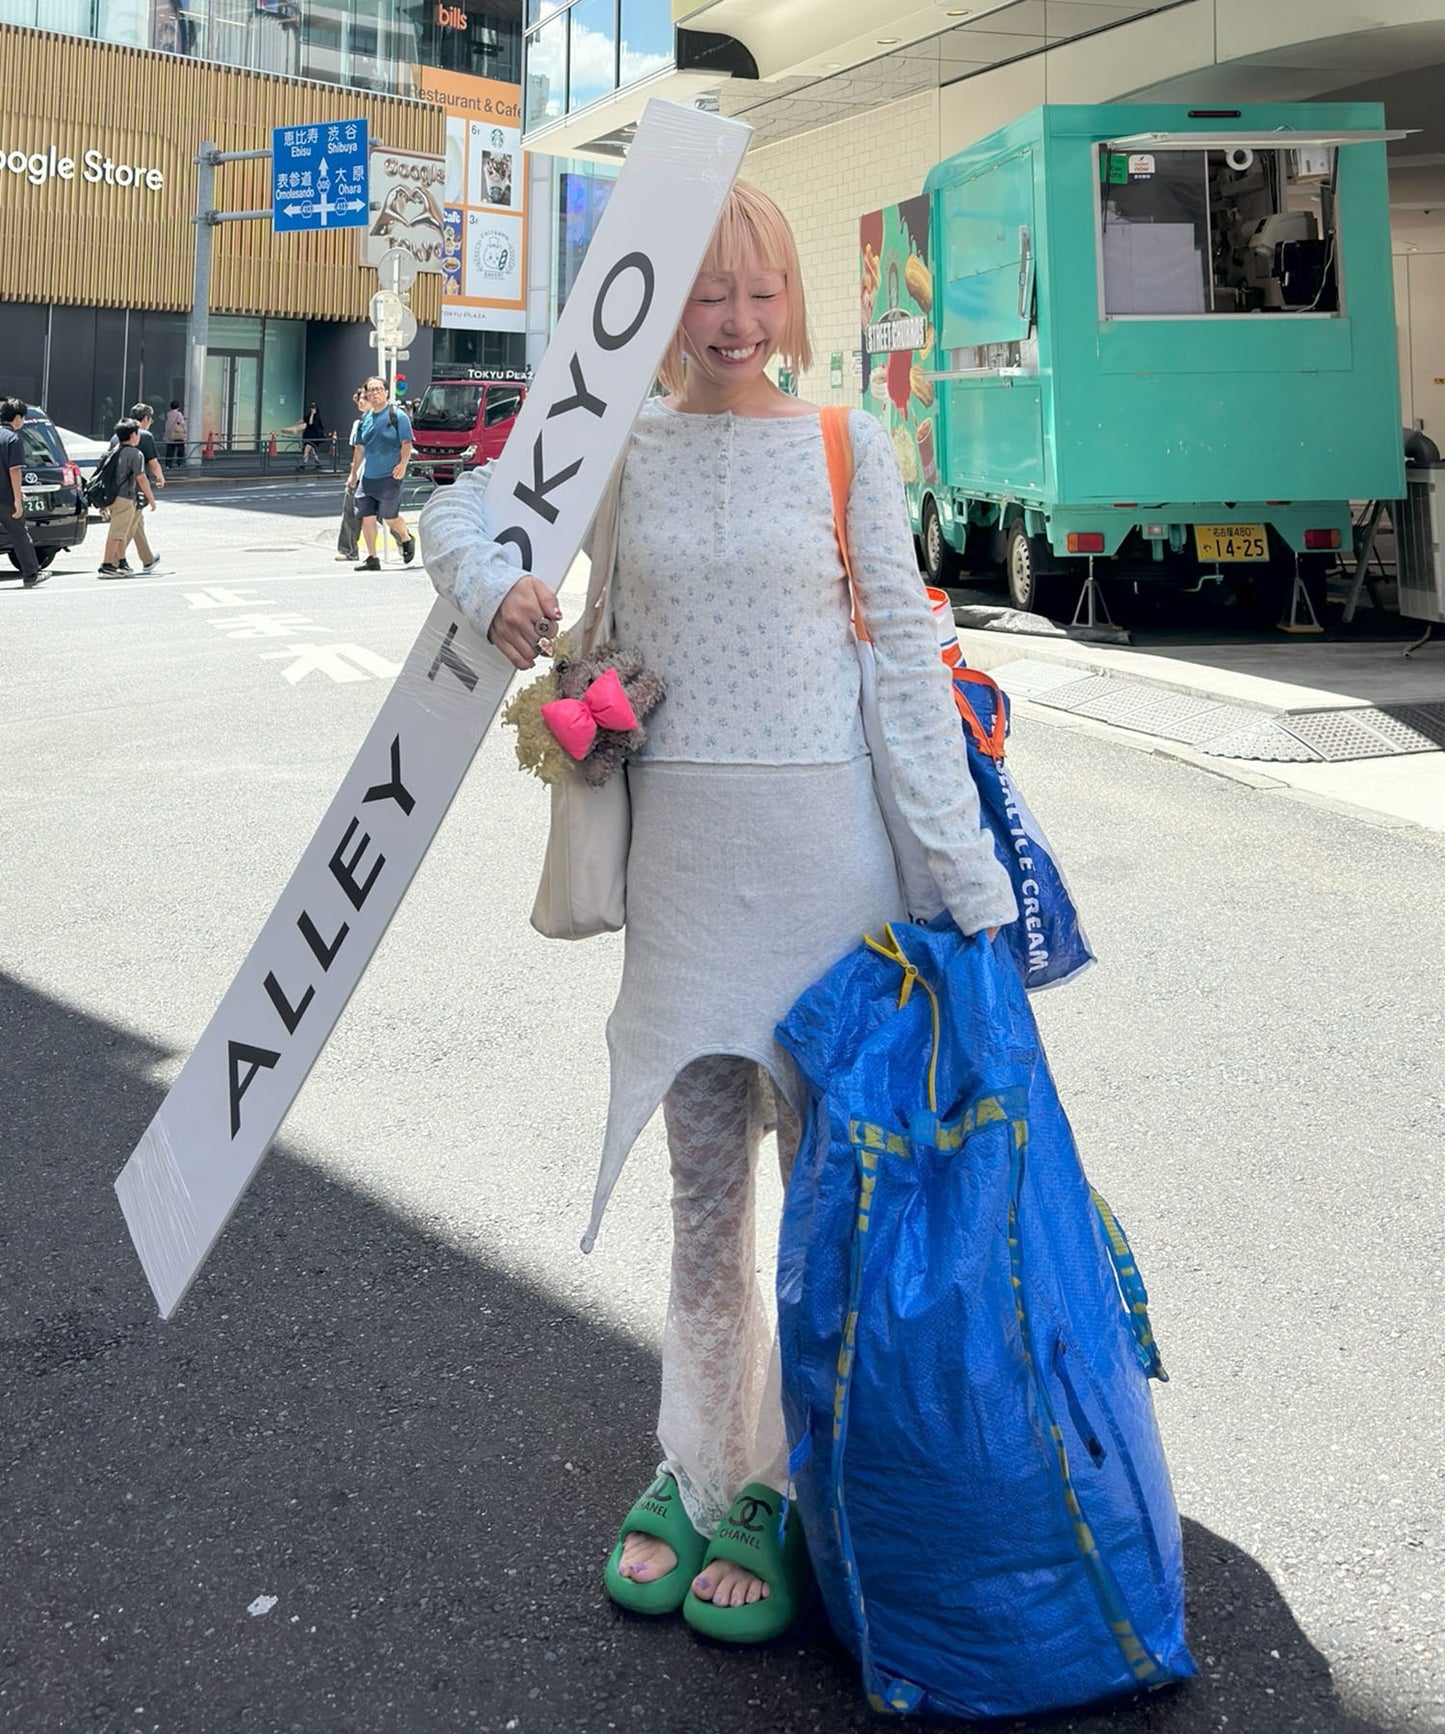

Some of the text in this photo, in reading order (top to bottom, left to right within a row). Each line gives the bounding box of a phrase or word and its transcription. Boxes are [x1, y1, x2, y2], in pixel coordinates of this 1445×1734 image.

[437, 4, 468, 31] bills
[484, 98, 493, 113] &
[284, 127, 318, 146] 恵比寿
[327, 124, 357, 142] 渋谷
[291, 146, 311, 158] Ebisu
[327, 142, 358, 154] Shibuya
[0, 145, 163, 191] ogle Store
[335, 165, 364, 183] 大原
[277, 171, 312, 188] 表参道
[275, 187, 315, 200] Omotesando
[338, 184, 362, 195] Ohara
[468, 369, 535, 380] TOKYU PLAZ
[1216, 539, 1264, 557] 14-25
[1022, 879, 1049, 974] CREAM
[228, 733, 416, 1141] ALLEY
[719, 1527, 761, 1549] CHANEL
